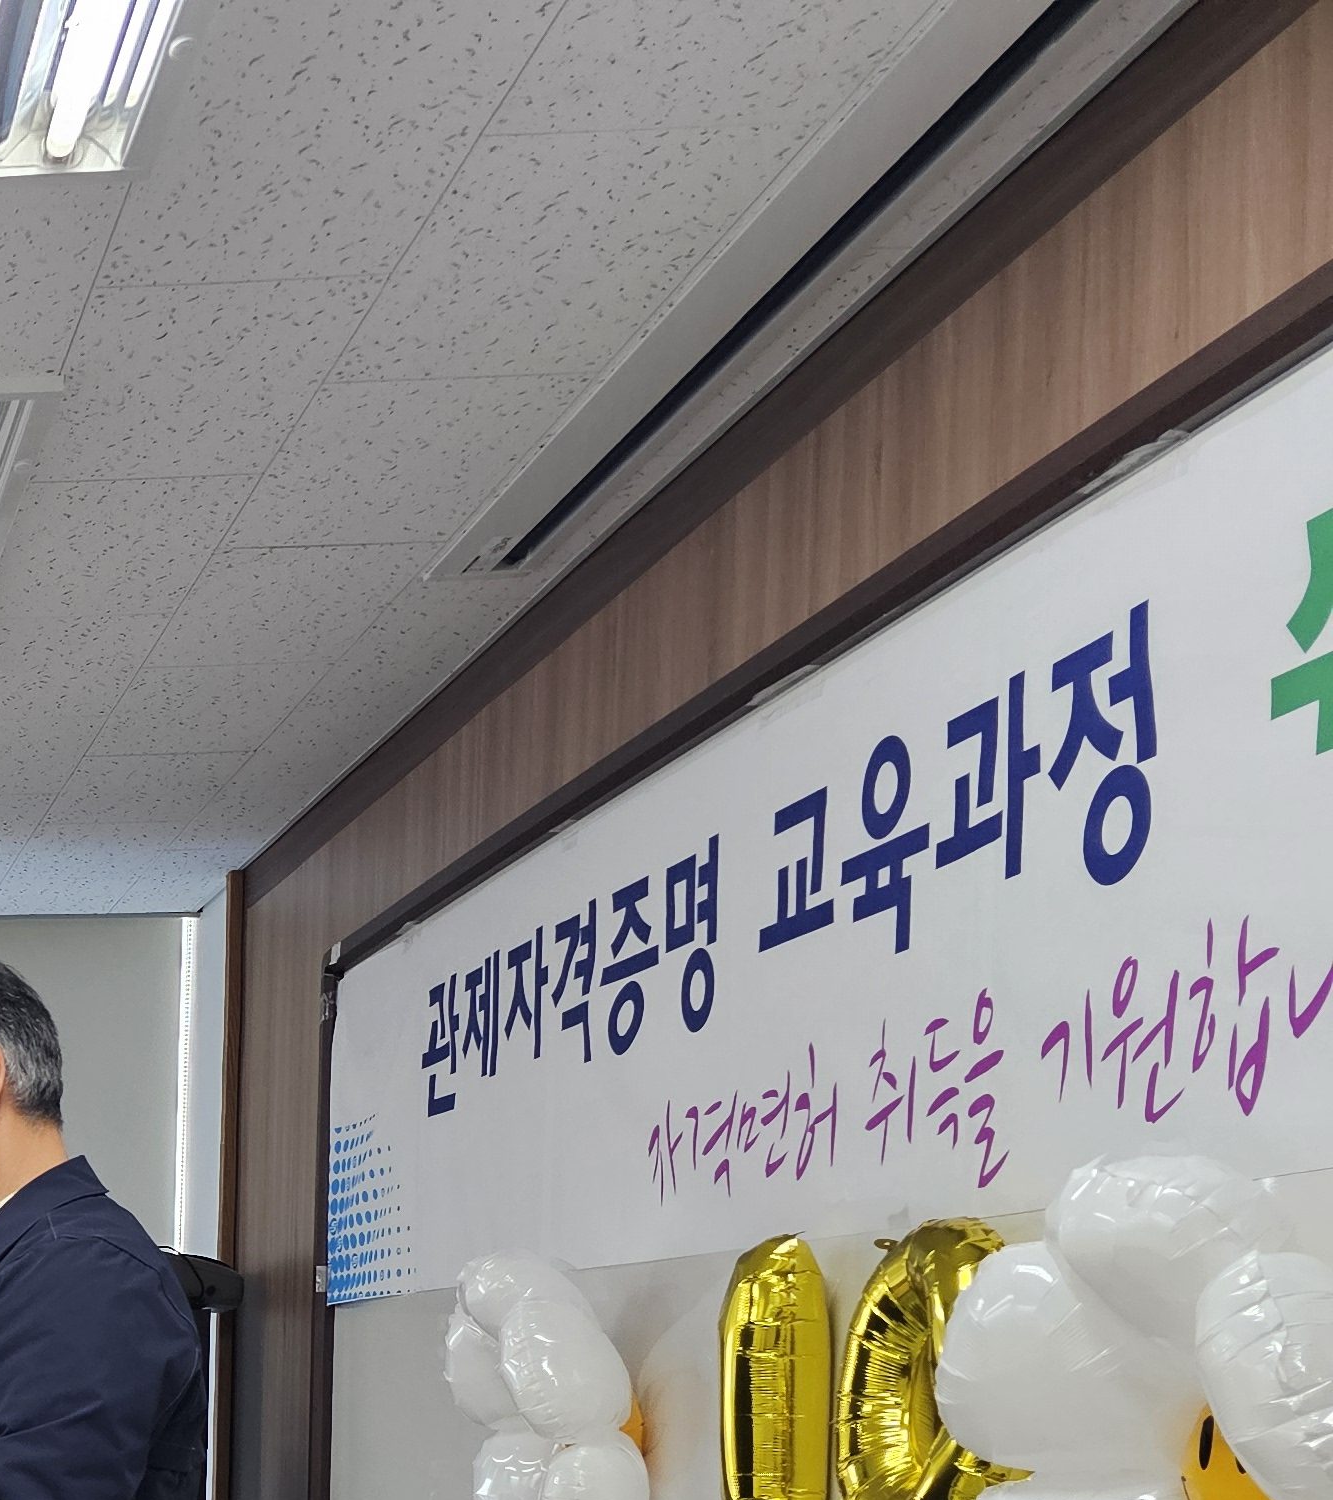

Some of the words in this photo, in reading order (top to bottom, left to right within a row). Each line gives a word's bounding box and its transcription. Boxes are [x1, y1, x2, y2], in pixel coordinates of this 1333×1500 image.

[421, 833, 719, 1117] 관제자격증명
[759, 600, 1157, 954] 교육과정
[648, 1043, 837, 1205] 자격면허
[865, 987, 1010, 1188] 취득을
